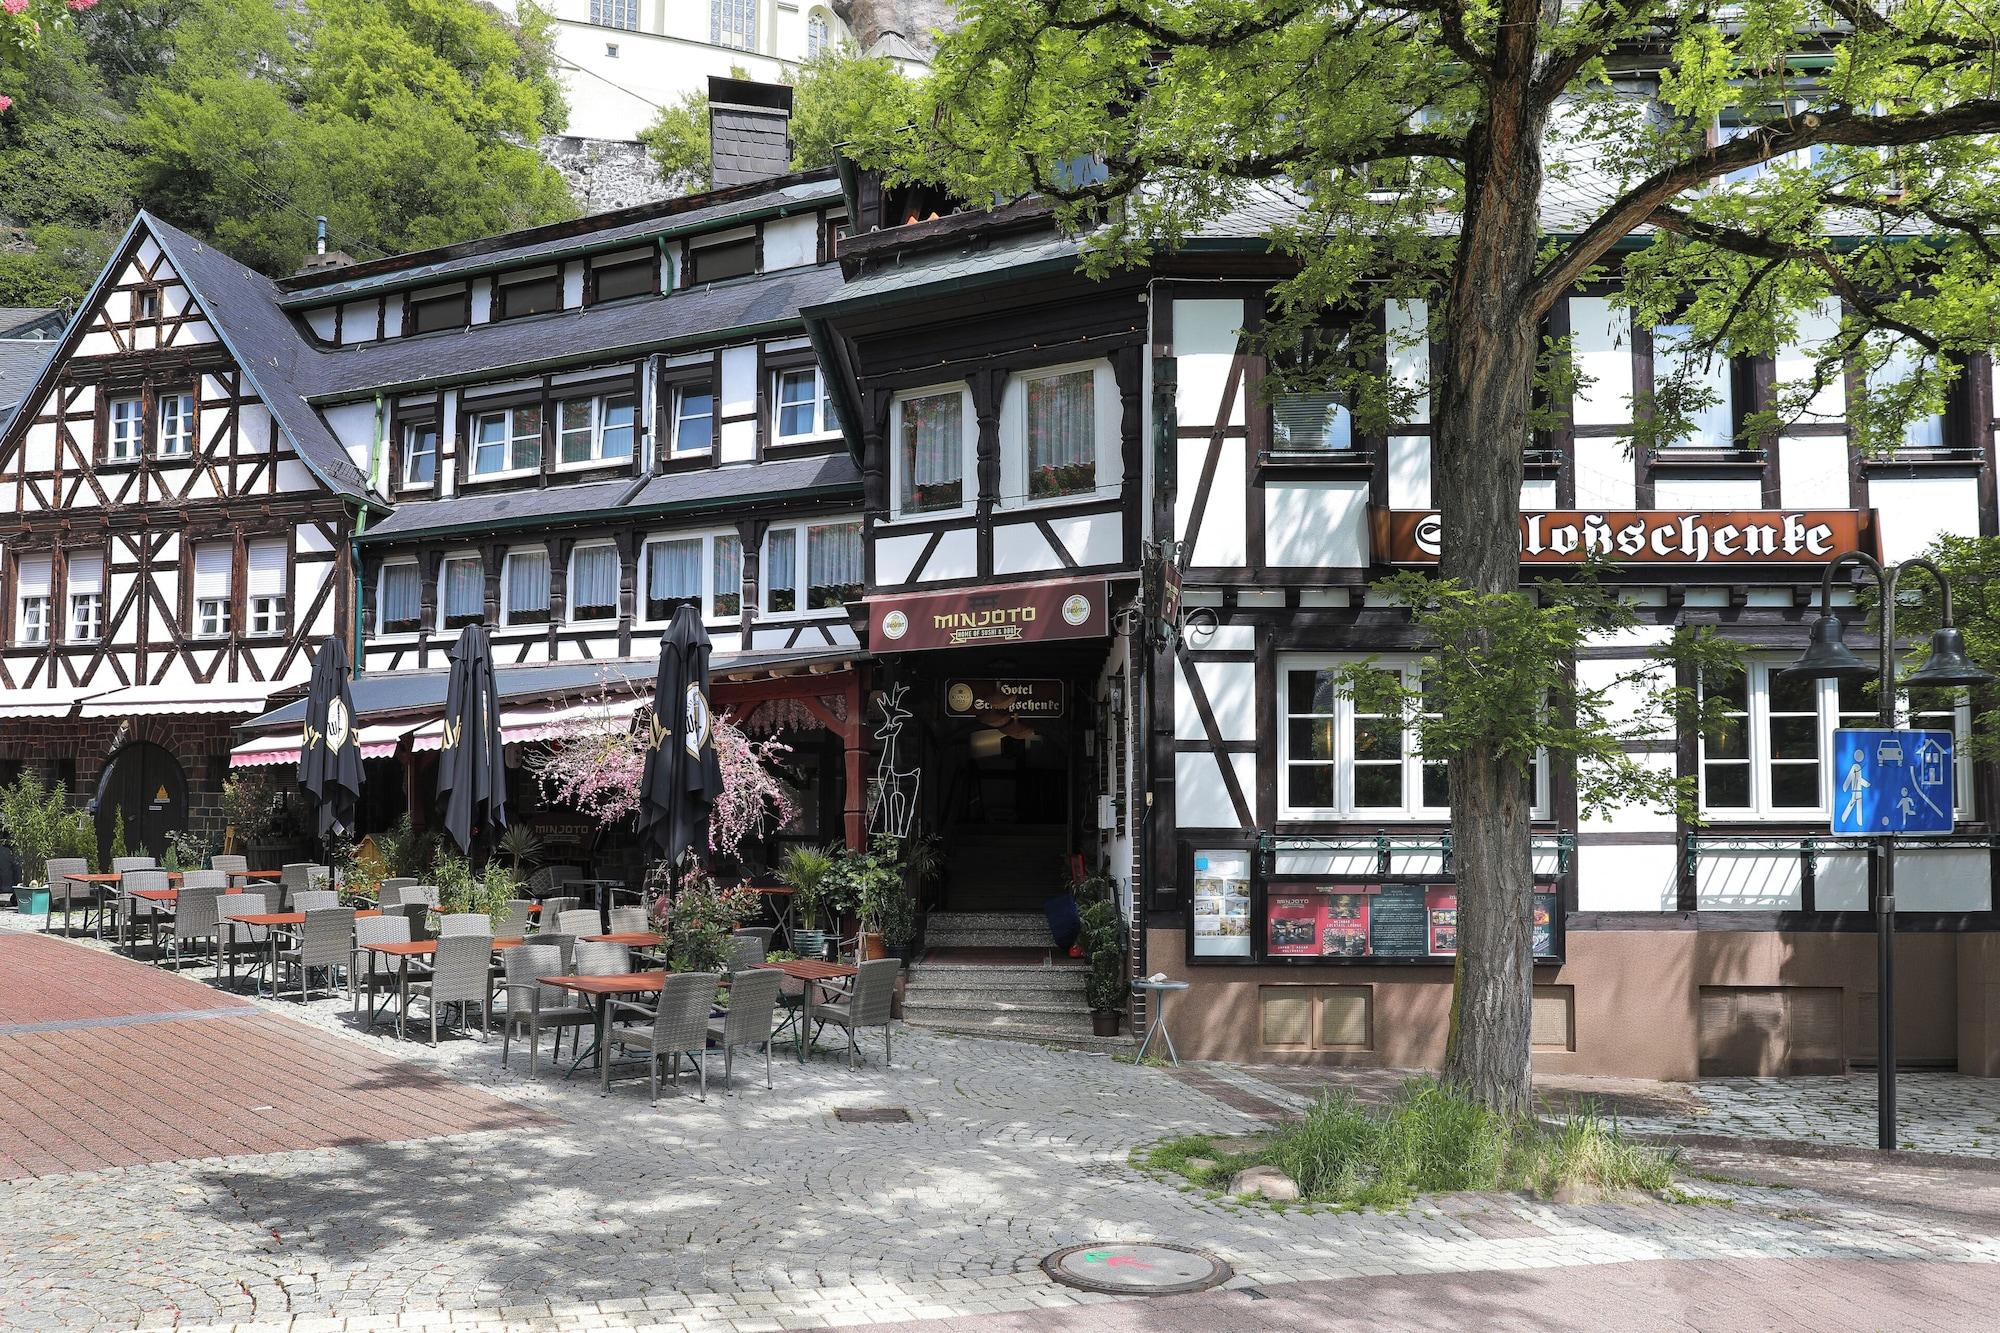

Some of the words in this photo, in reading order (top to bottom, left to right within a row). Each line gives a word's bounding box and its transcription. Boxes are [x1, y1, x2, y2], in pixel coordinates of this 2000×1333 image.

[1414, 514, 1834, 562] Sloßschenke
[933, 606, 1037, 629] MINJOTO
[957, 630, 972, 638] HOME
[981, 628, 997, 636] SUSHI
[1000, 684, 1033, 695] Hotel
[535, 824, 589, 833] MINJOTO
